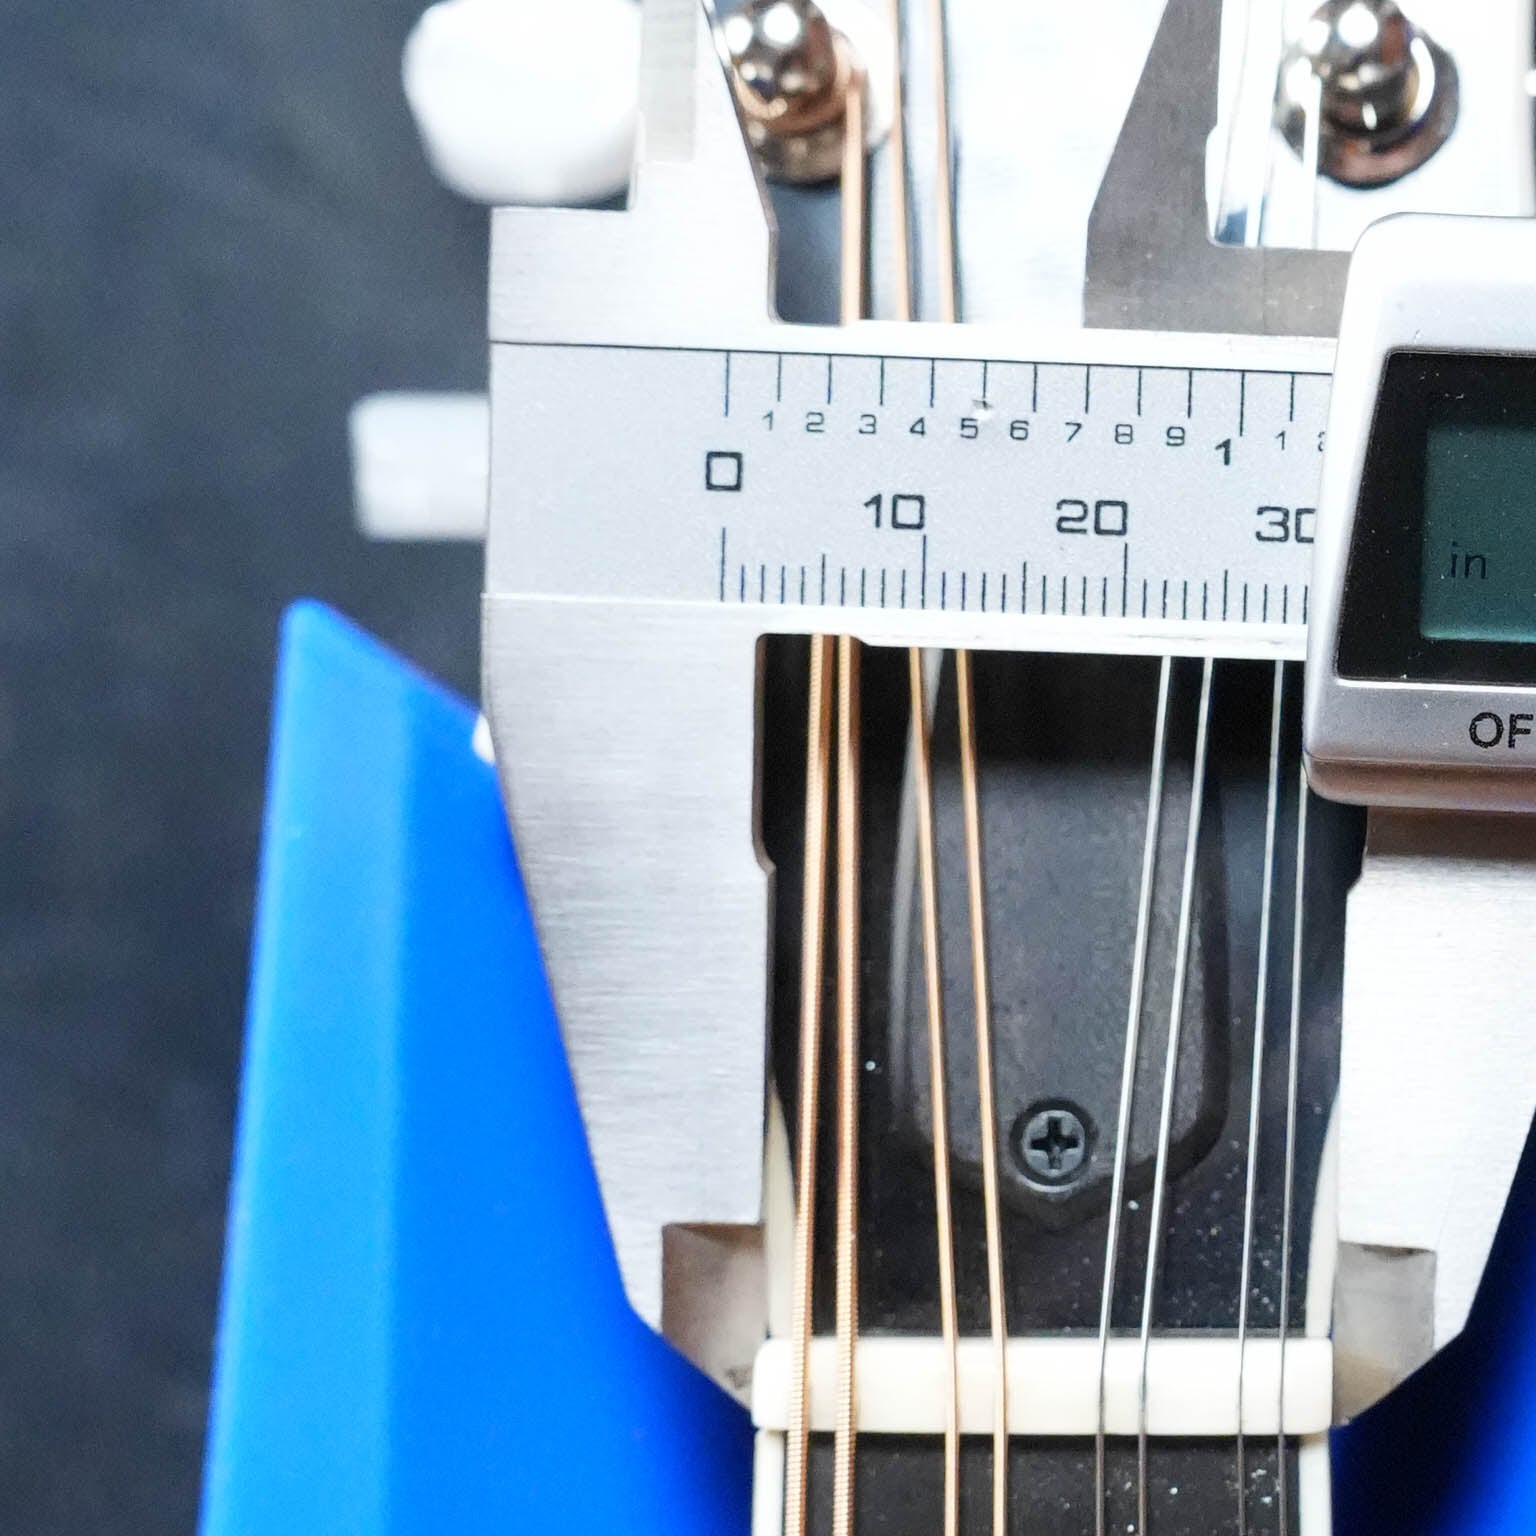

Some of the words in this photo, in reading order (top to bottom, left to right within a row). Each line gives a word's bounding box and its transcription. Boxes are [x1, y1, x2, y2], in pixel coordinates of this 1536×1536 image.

[761, 409, 775, 432] 1
[805, 411, 825, 433] 2
[857, 413, 877, 435] 3
[908, 416, 926, 437] 4
[959, 417, 979, 439] 5
[1009, 419, 1030, 441] 6
[1064, 421, 1083, 443] 7
[1113, 423, 1134, 445] 8
[1165, 425, 1186, 447] 9
[1214, 438, 1232, 466] 1
[1274, 429, 1287, 451] 1
[705, 450, 743, 492] 0
[863, 493, 926, 530] 10
[1055, 498, 1129, 536] 20
[1449, 544, 1489, 580] in
